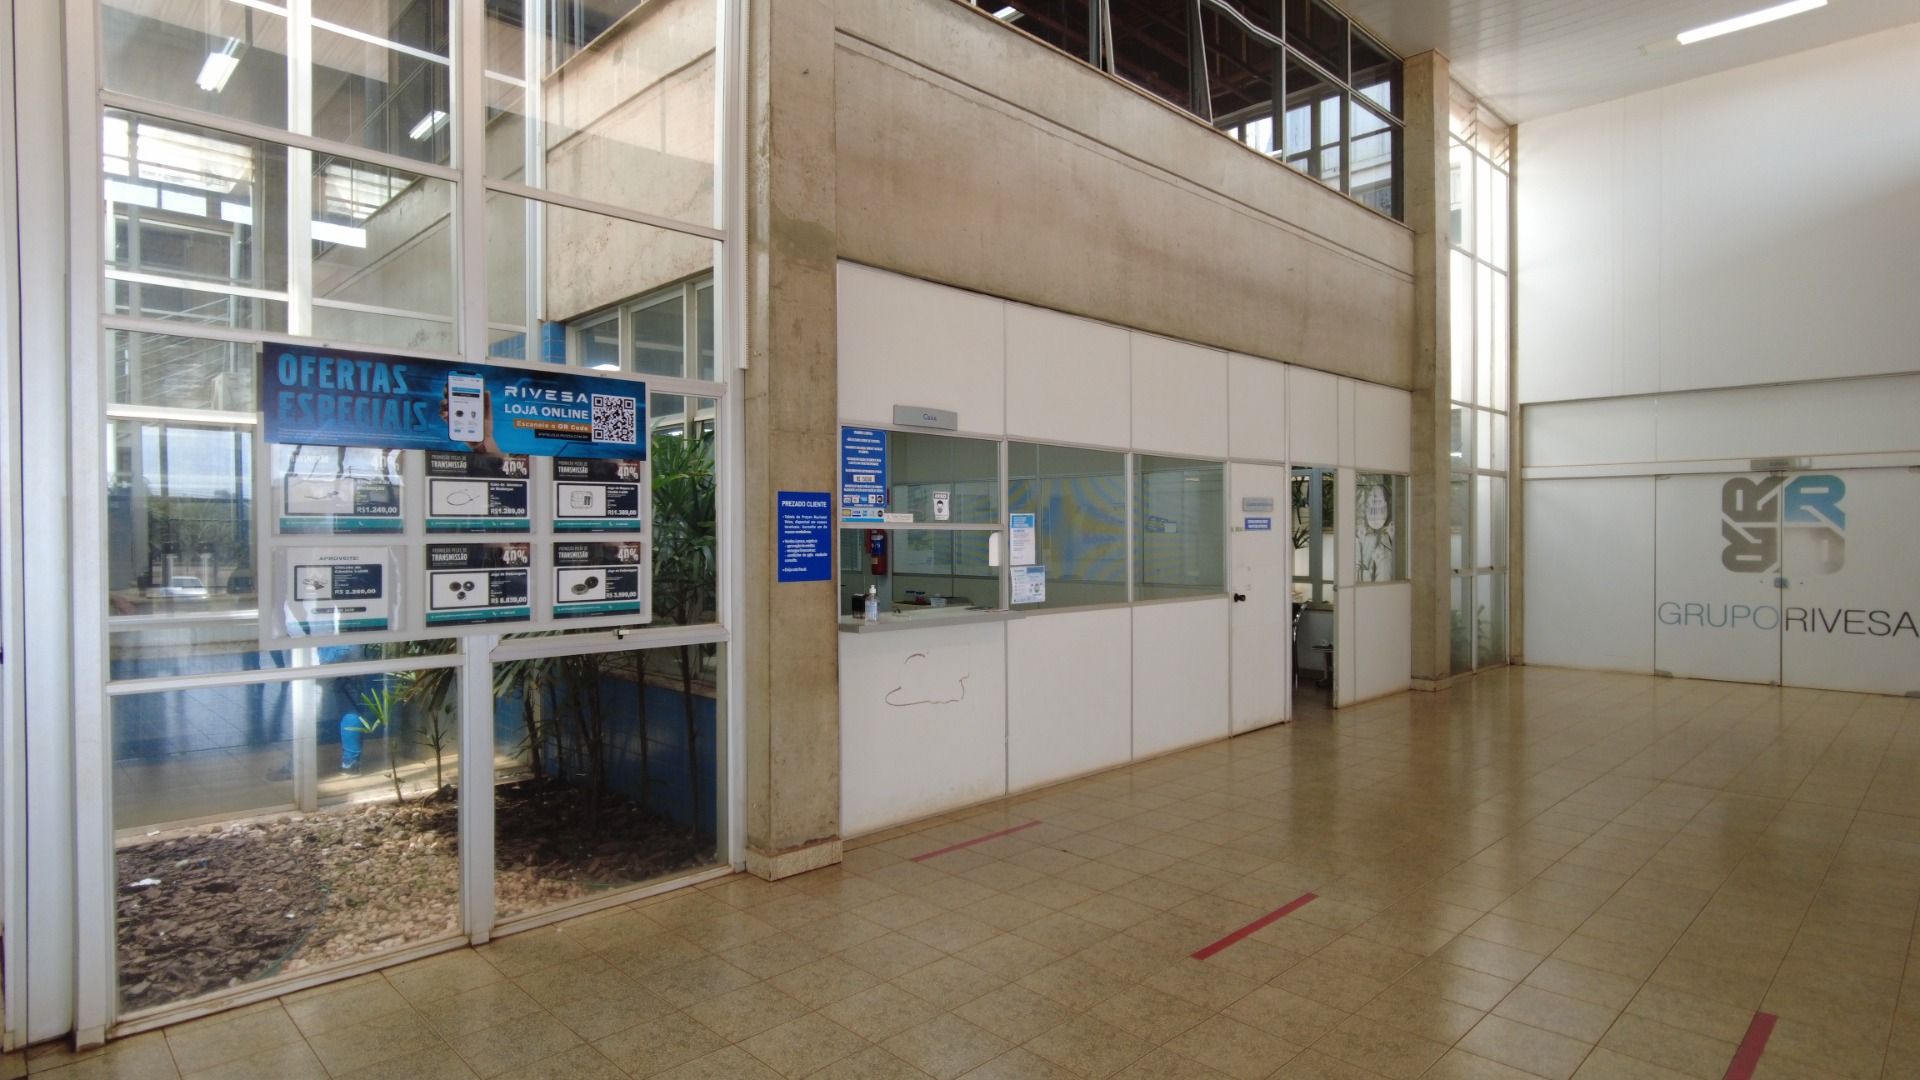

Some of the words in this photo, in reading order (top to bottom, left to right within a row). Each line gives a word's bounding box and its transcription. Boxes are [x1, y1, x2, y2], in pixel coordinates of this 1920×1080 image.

[278, 353, 408, 394] OFERTAS
[504, 386, 588, 403] RIVESA
[279, 391, 428, 432] ESPECIAIS
[504, 404, 538, 416] LOJA
[541, 407, 589, 419] ONLINE
[502, 460, 527, 475] 40%
[617, 465, 639, 480] 40%
[503, 549, 528, 565] 40%
[617, 548, 639, 562] 40%
[1657, 601, 1780, 630] GRUPO
[1785, 607, 1919, 638] RIVESA
